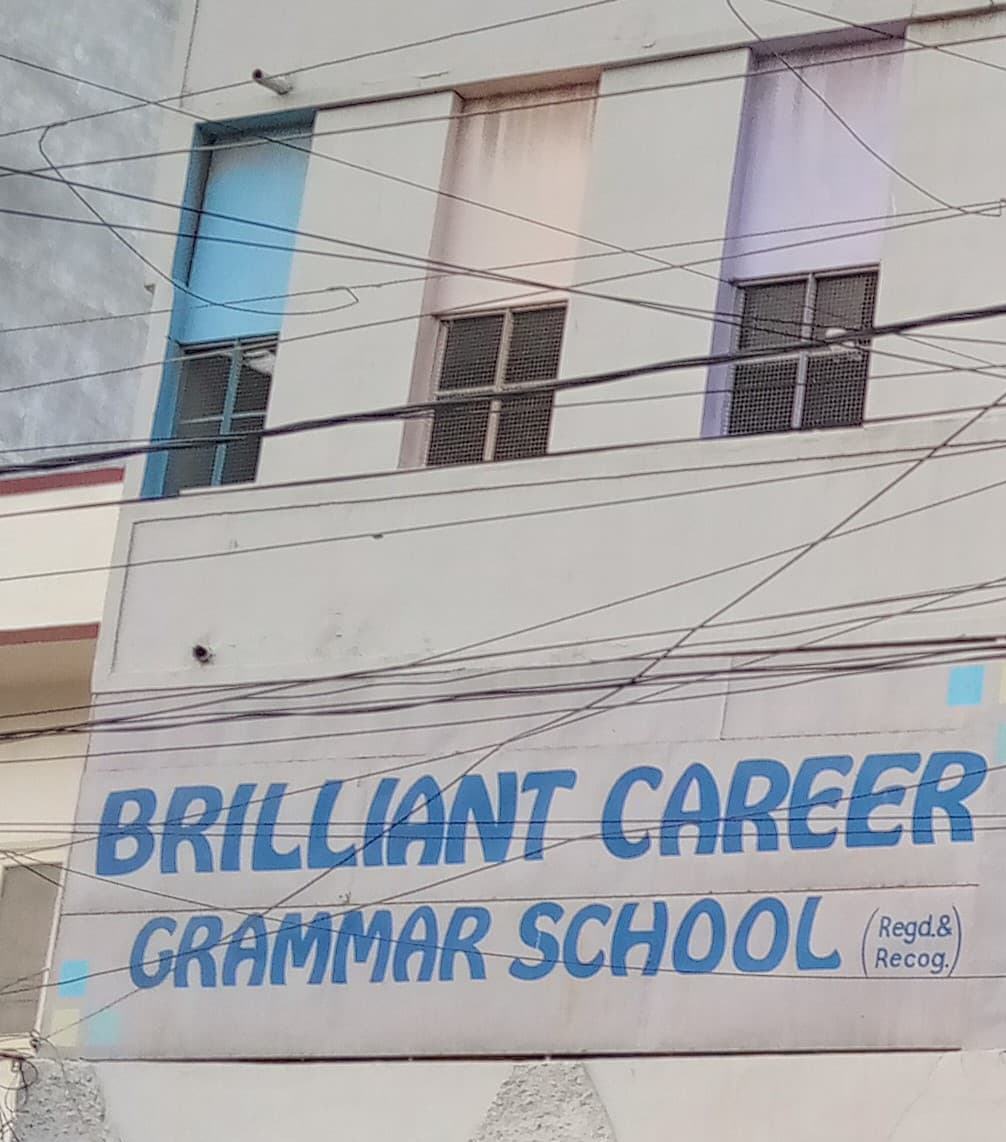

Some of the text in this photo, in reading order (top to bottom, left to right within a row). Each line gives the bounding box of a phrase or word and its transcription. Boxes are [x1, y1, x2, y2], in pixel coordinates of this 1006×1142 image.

[95, 749, 990, 877] BRILLIANT CAREER
[130, 895, 841, 989] GRAMMAR SCHOOL
